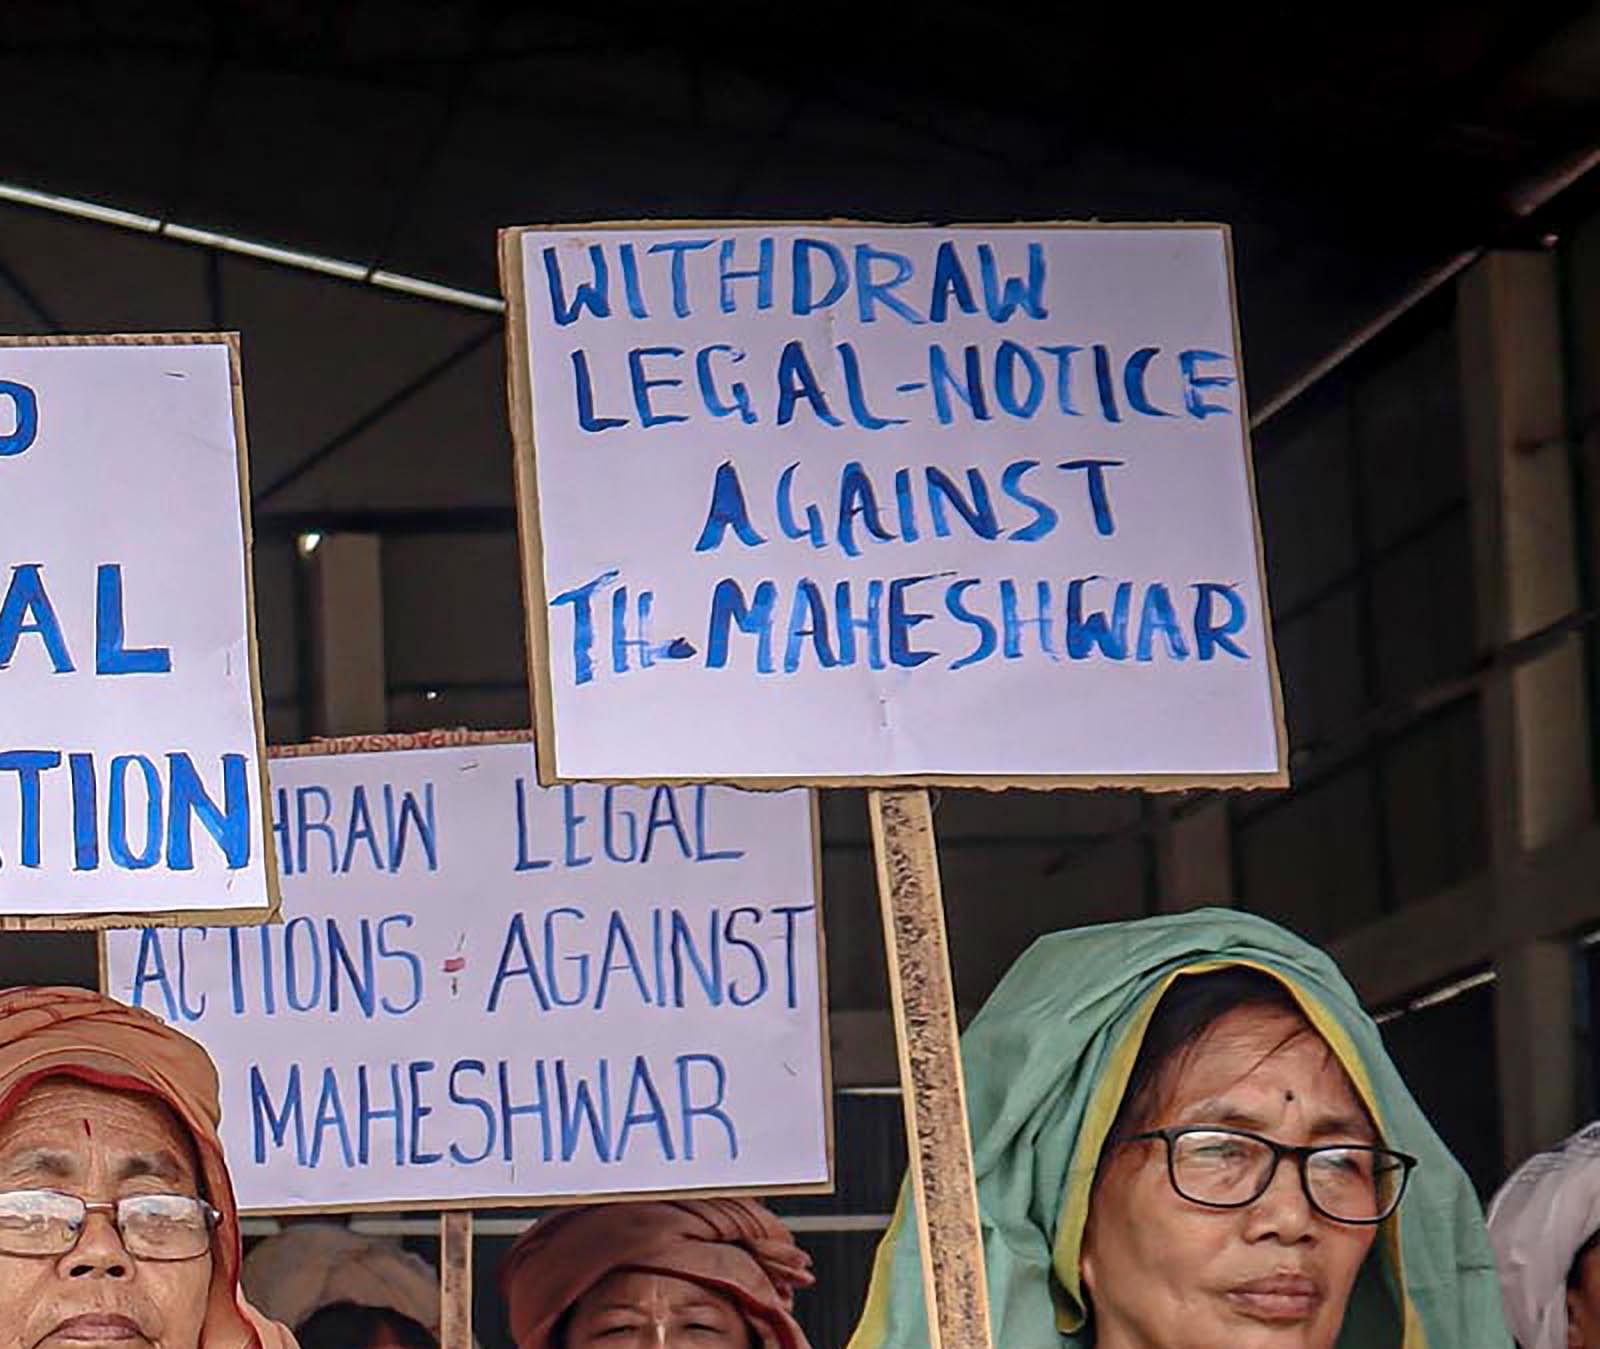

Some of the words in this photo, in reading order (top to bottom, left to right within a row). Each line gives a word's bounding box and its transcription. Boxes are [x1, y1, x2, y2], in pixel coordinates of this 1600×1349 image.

[542, 238, 1049, 327] WITHDRAW
[694, 459, 1123, 557] AGAINST
[514, 778, 744, 872] LEGAL
[487, 905, 816, 1012] AGAINST
[250, 1054, 738, 1169] MAHESHWAR
